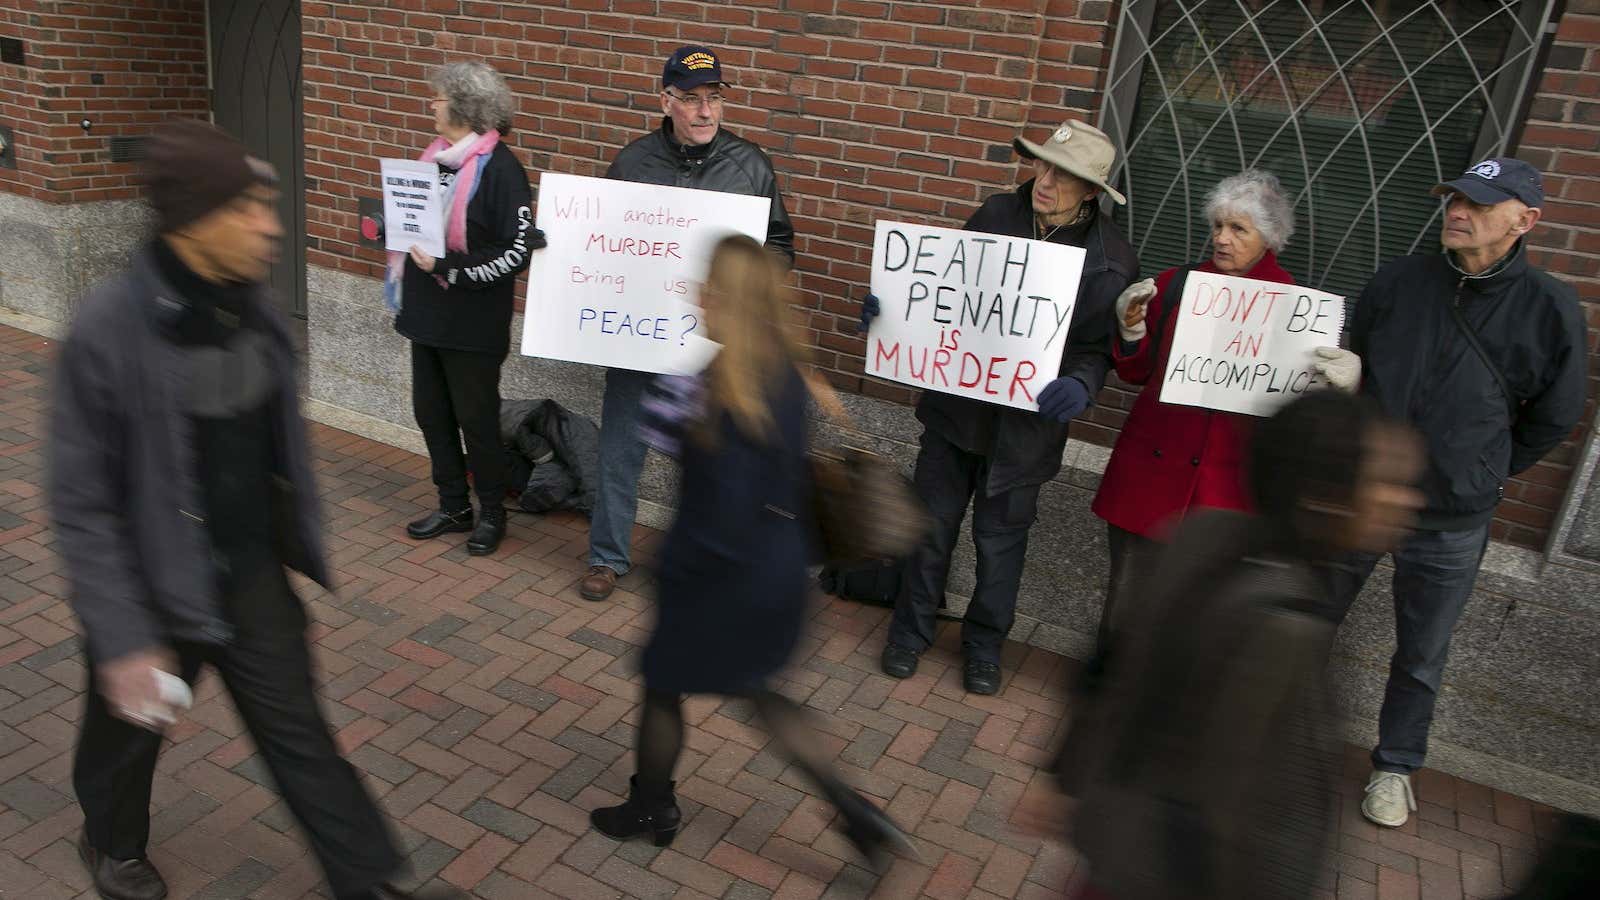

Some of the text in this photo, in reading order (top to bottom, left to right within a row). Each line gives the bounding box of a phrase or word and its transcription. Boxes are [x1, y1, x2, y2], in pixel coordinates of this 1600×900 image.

[554, 196, 698, 229] Will another
[585, 234, 682, 259] MURDER
[884, 230, 1030, 291] DEATH
[571, 265, 688, 295] Bring us
[905, 281, 1071, 351] PENALTY
[1191, 282, 1333, 335] DON'T BE
[1224, 330, 1264, 358] AN
[875, 338, 1037, 402] MURDER
[1168, 354, 1325, 395] ACCOMPLICE
